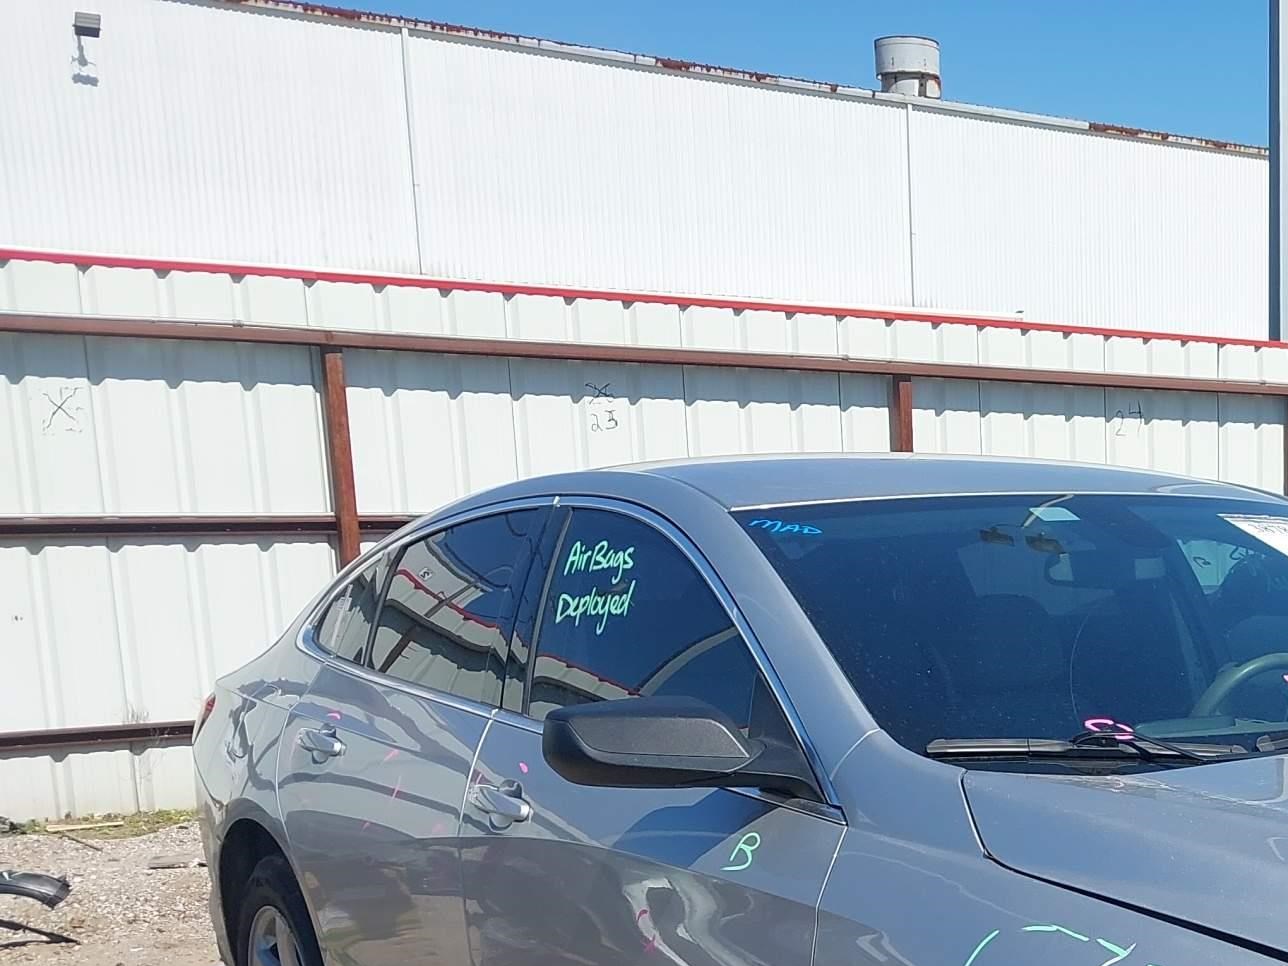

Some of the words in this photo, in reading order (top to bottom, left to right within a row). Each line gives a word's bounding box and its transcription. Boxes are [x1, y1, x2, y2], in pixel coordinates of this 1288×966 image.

[748, 519, 823, 534] MAD
[555, 579, 637, 635] Deployed
[720, 832, 761, 871] B
